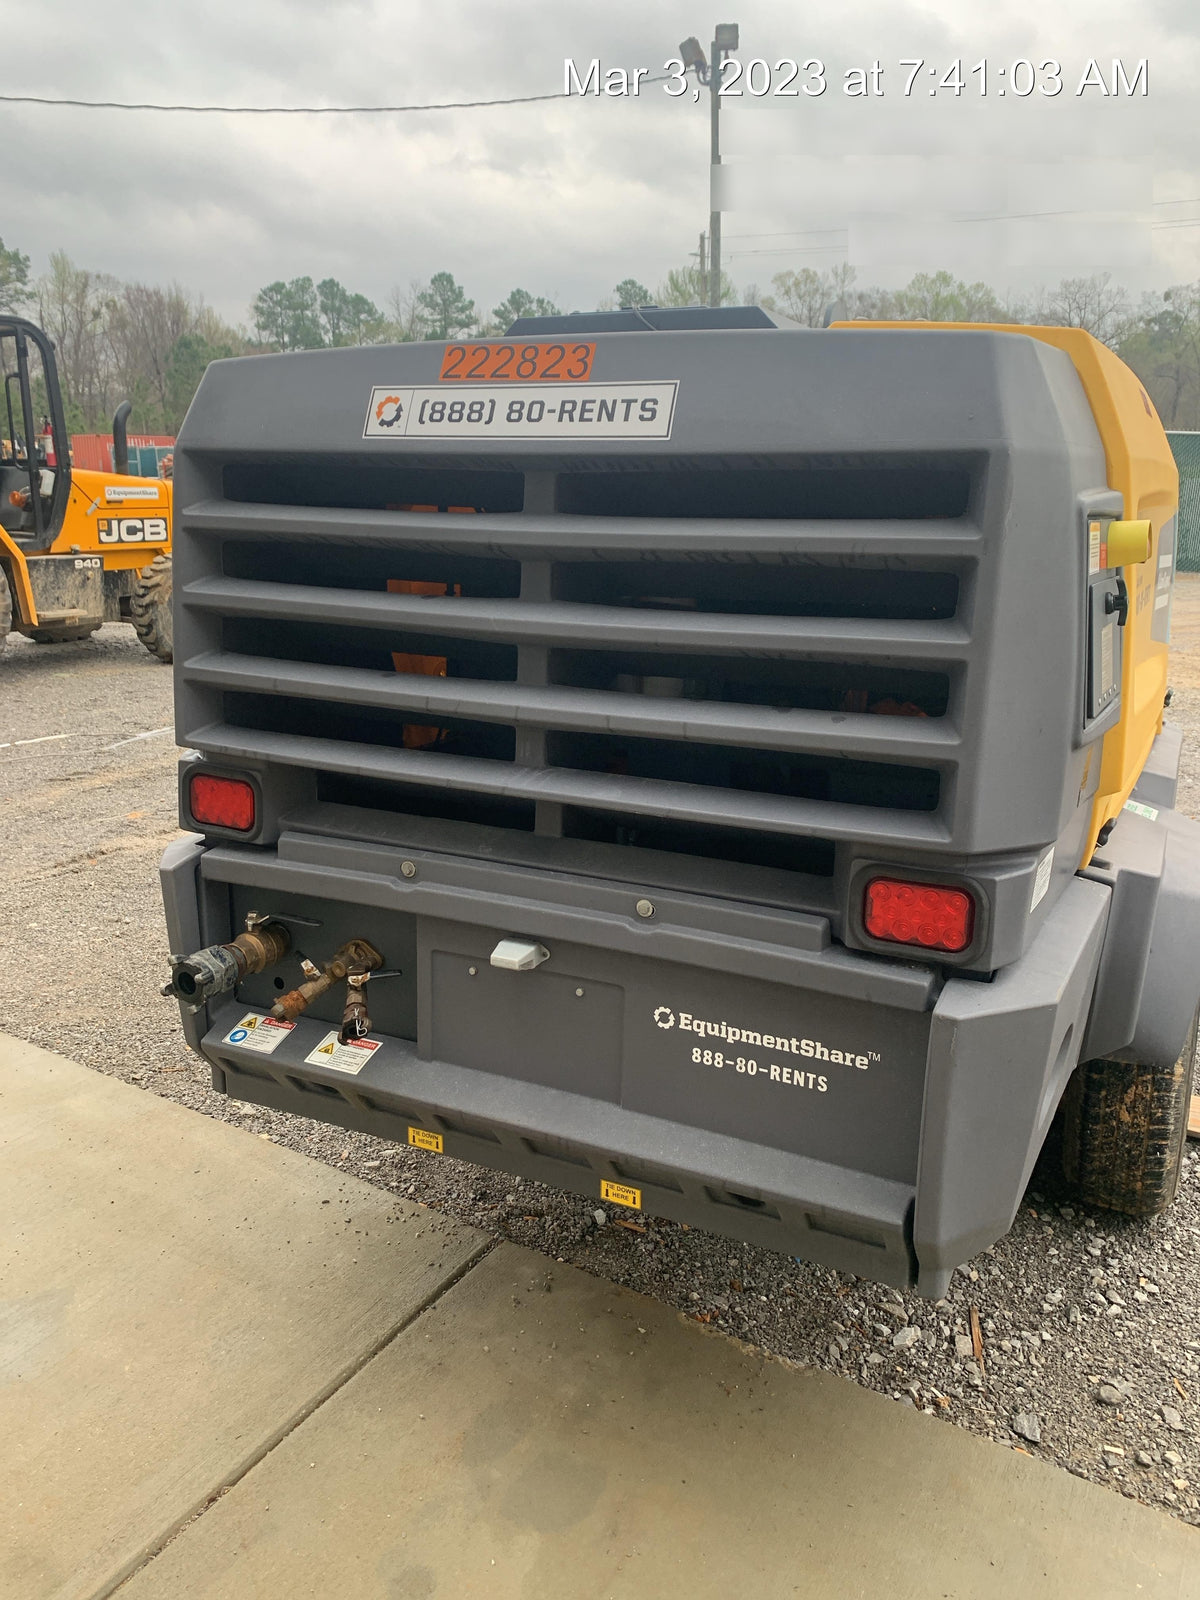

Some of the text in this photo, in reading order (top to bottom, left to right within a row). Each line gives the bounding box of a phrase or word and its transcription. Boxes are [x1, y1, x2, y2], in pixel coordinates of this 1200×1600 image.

[442, 343, 591, 379] 222823
[418, 397, 660, 425] (888) 80-RENTS
[99, 518, 168, 544] JCB
[74, 559, 101, 570] 940
[678, 1011, 870, 1071] EquipmentShare
[690, 1047, 829, 1093] 888-80-RENTS
[418, 1138, 433, 1147] HERE
[421, 1131, 439, 1141] DOWN
[606, 1182, 637, 1196] TIE DOWN
[612, 1191, 630, 1202] HERE
